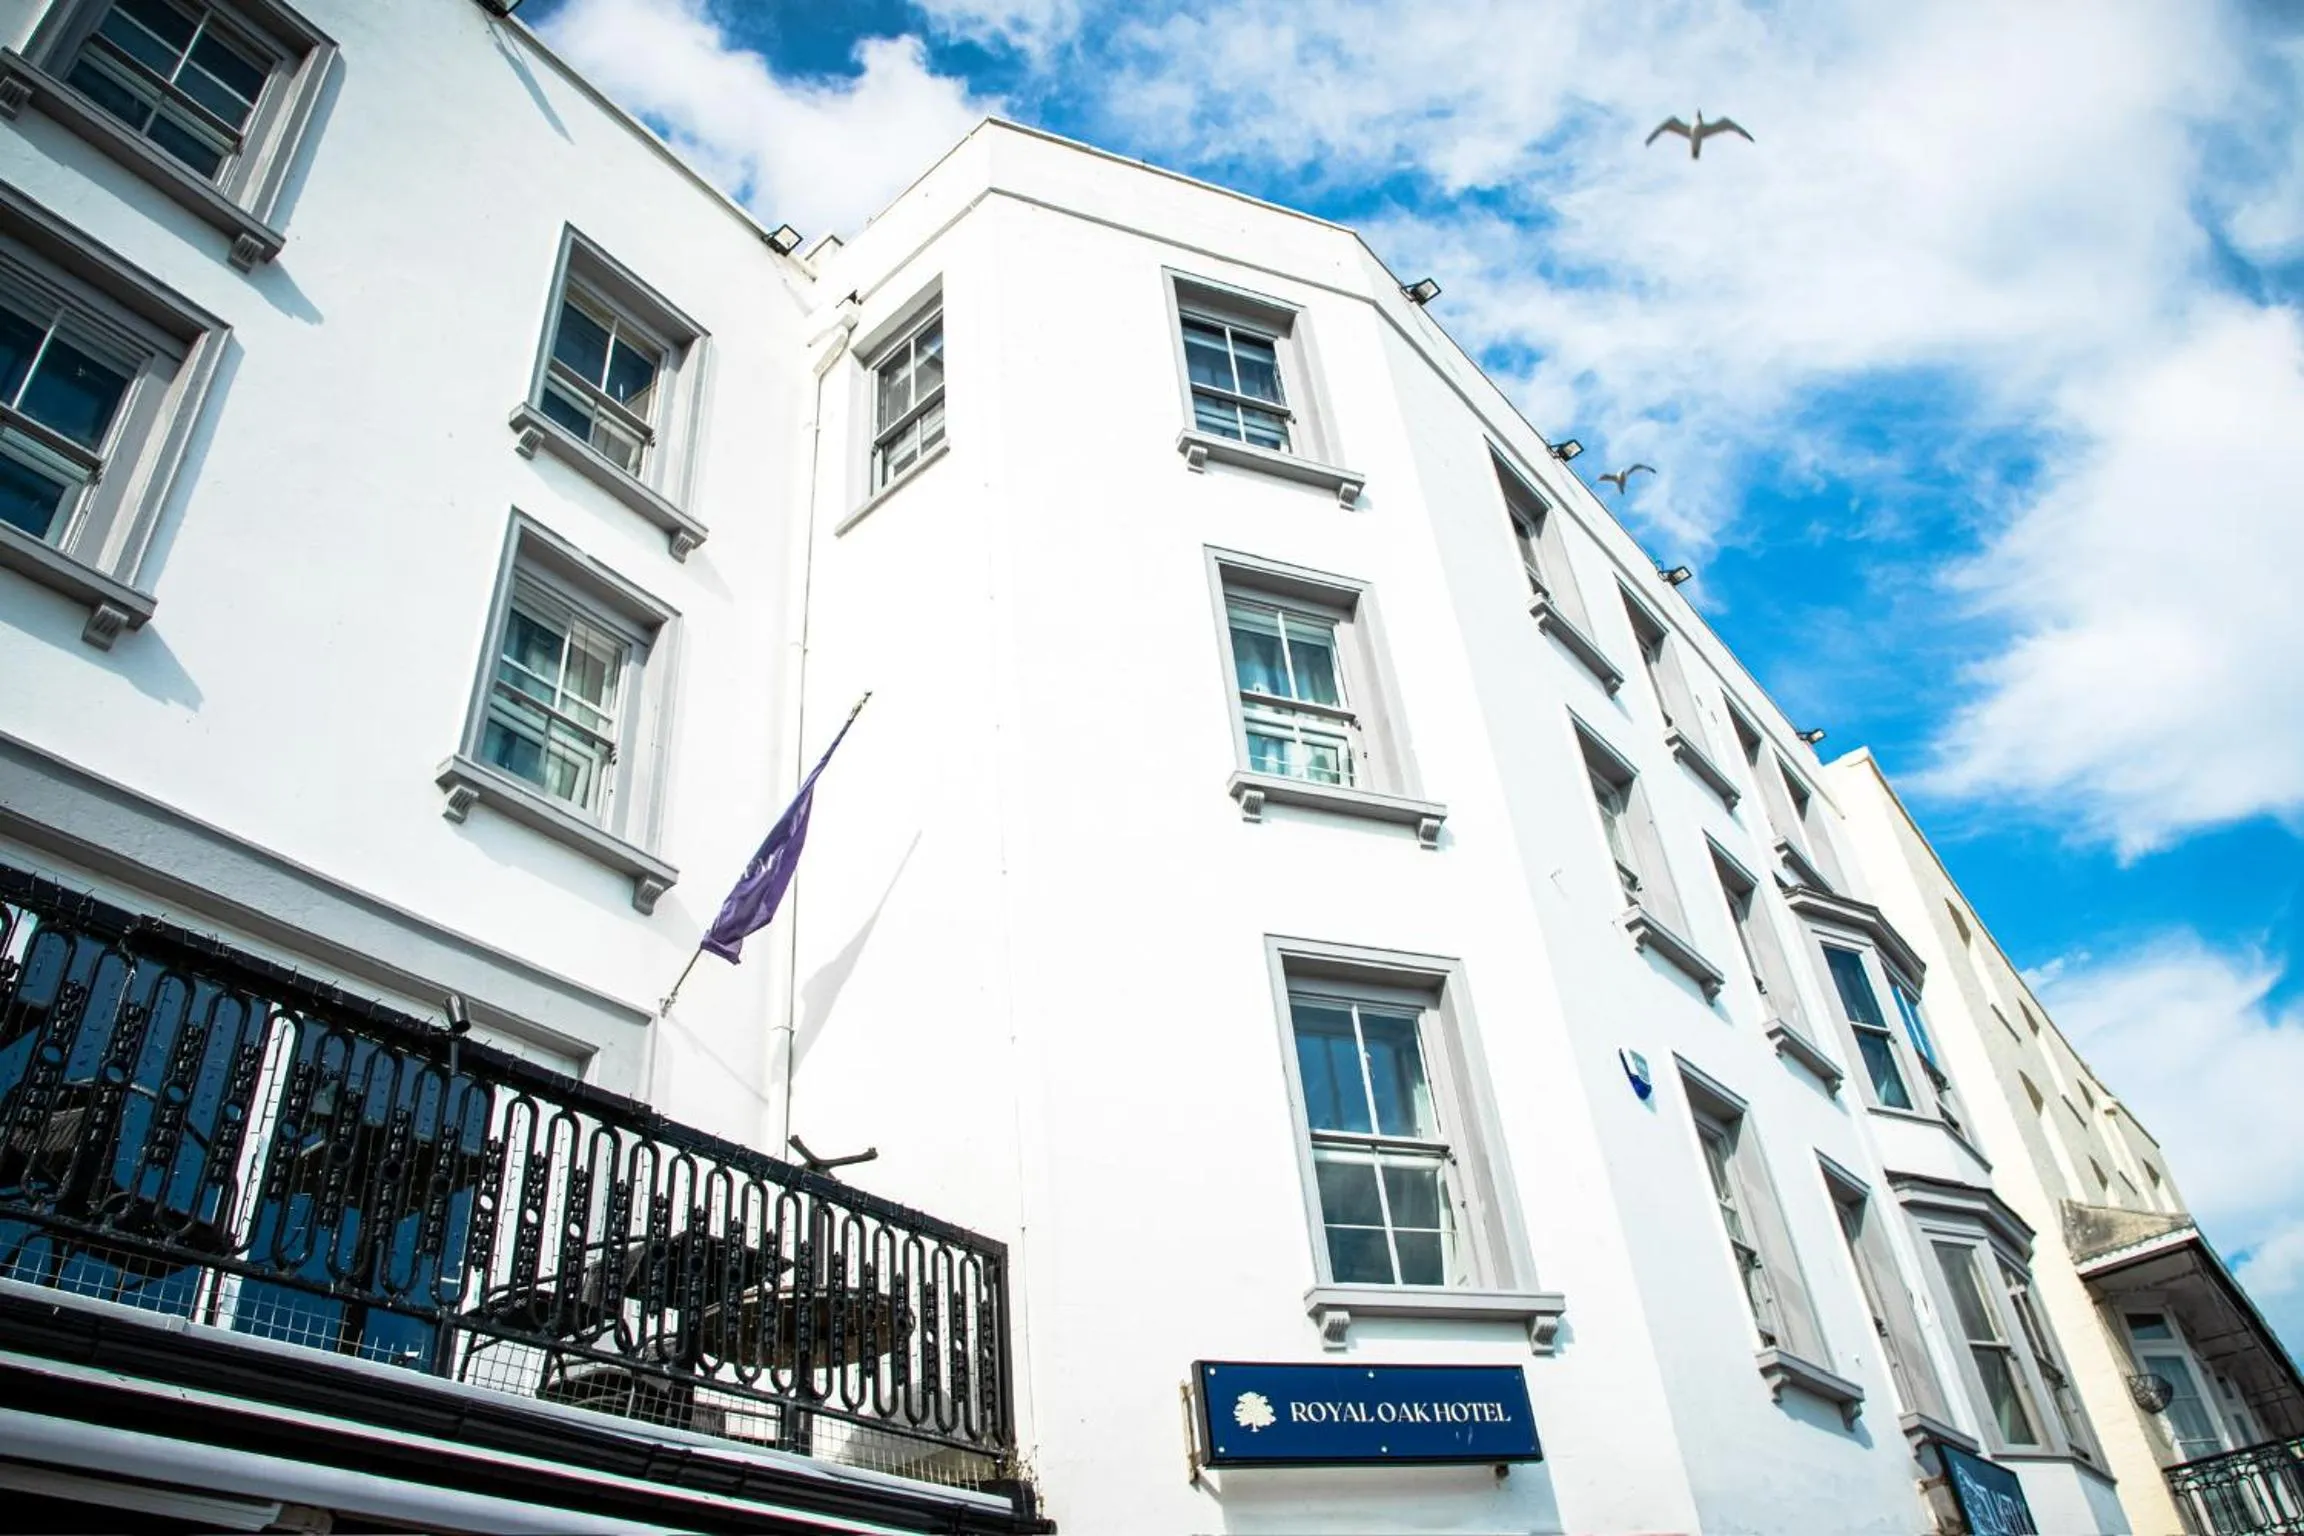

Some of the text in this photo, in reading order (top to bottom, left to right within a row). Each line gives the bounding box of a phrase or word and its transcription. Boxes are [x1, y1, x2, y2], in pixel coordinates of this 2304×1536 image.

[1290, 1402, 1511, 1423] ROYAL OAK HOTEL
